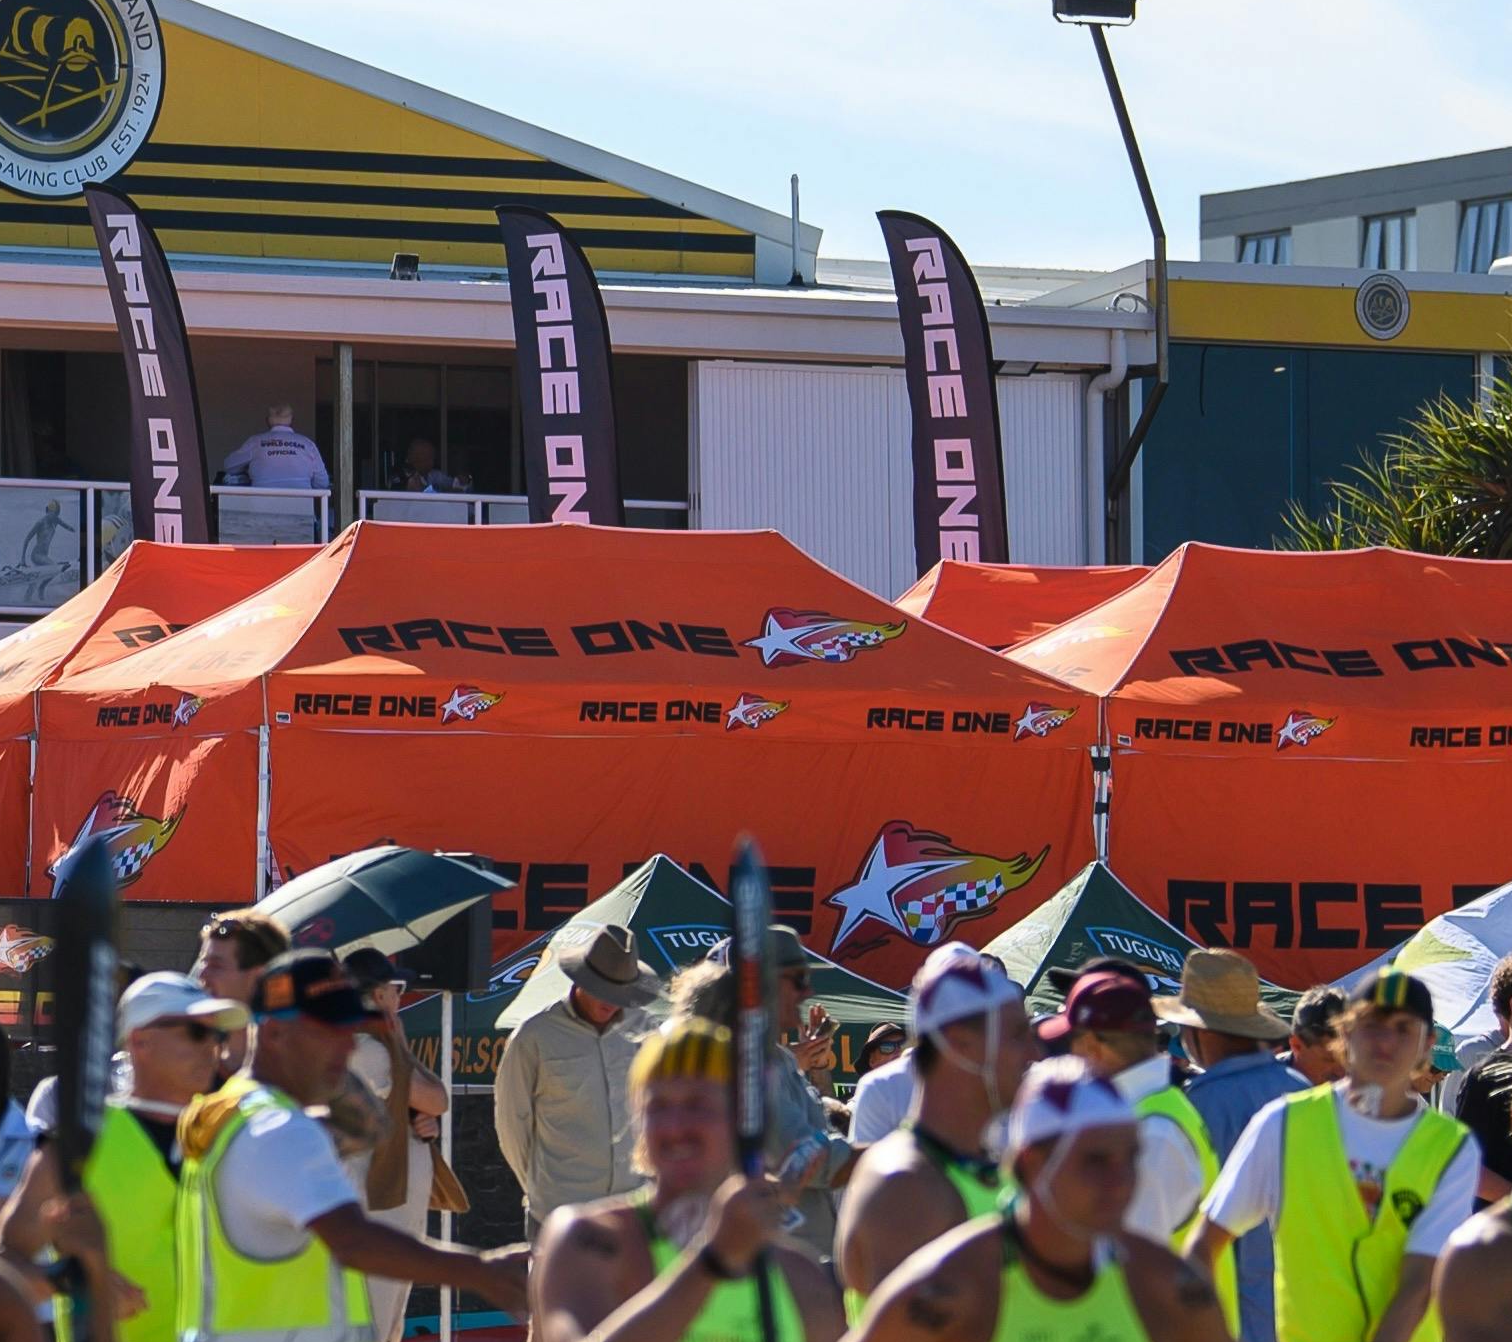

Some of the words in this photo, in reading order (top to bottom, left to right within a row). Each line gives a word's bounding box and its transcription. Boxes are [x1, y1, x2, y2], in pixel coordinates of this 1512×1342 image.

[133, 71, 151, 114] 1924
[62, 154, 109, 186] CLUB
[106, 213, 167, 398] RACE
[526, 232, 581, 415] RACE
[904, 236, 968, 419] RACE
[933, 438, 981, 563] ONE
[337, 618, 560, 658] RACE
[570, 620, 741, 658] ONE
[1169, 638, 1385, 678] RACE
[96, 706, 141, 727] RACE
[142, 703, 174, 725] ONE
[294, 692, 372, 716] RACE
[379, 694, 437, 718] ONE
[579, 701, 657, 723] RACE
[665, 700, 722, 723] ONE
[867, 707, 945, 733] RACE
[952, 709, 1011, 734] ONE
[1134, 718, 1212, 742] RACE
[1218, 721, 1273, 745] ONE
[1410, 726, 1482, 748] RACE
[1166, 878, 1425, 949] RACE
[1100, 932, 1181, 967] TUGUN
